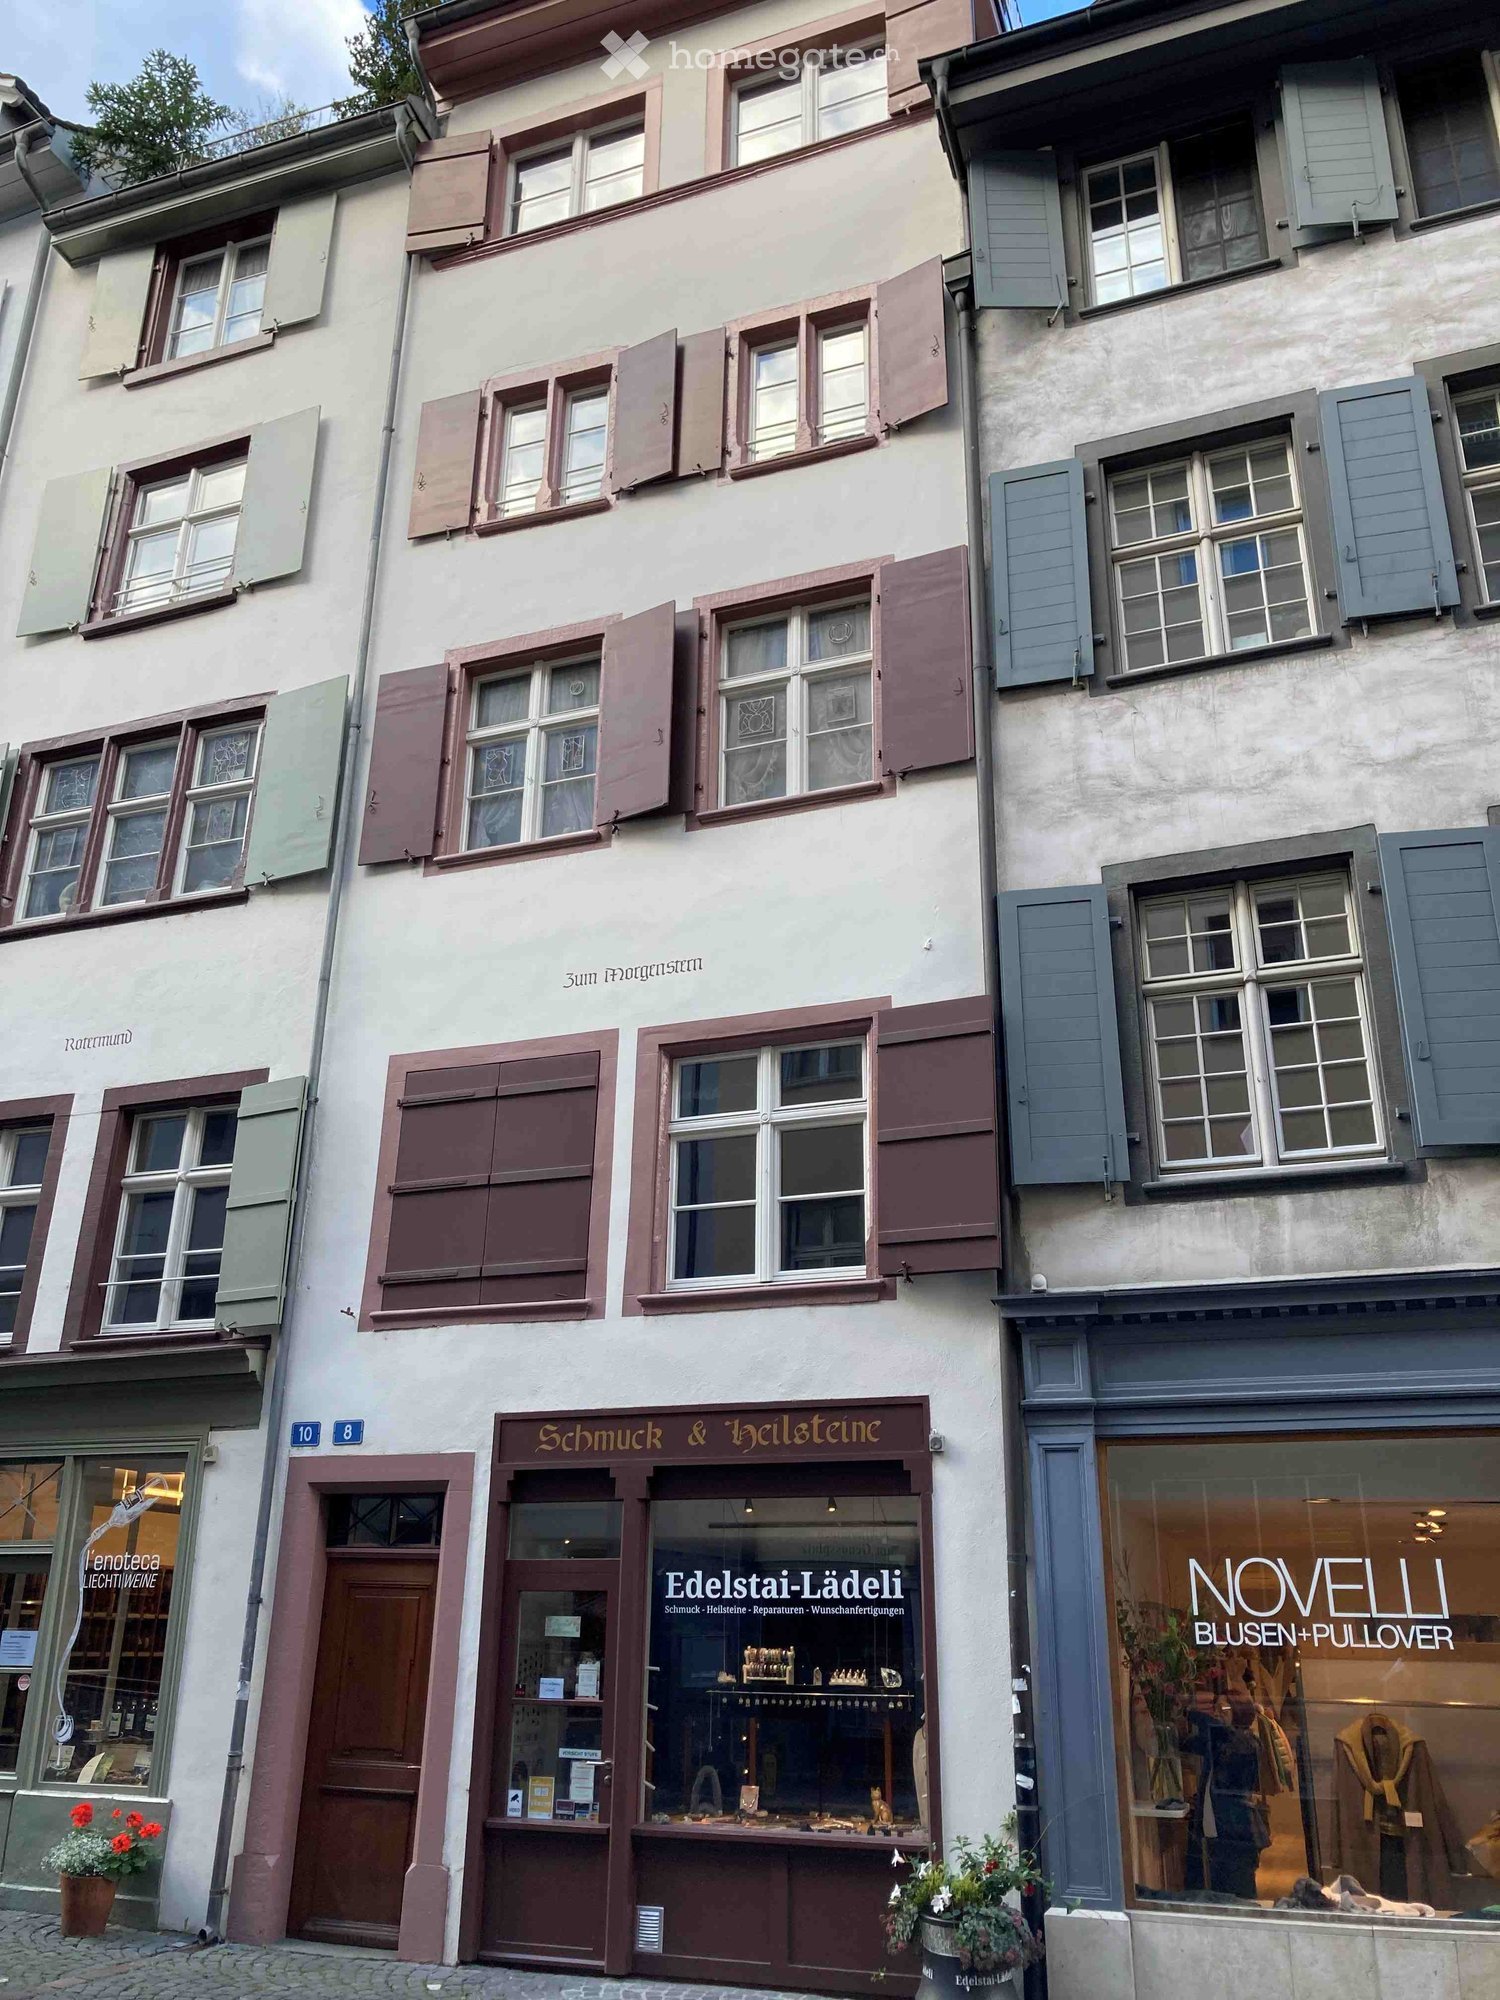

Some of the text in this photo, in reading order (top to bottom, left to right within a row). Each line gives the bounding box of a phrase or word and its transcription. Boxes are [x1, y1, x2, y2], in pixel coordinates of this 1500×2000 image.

[563, 957, 702, 988] Zum Morgenstern
[64, 1029, 133, 1051] Rotermund
[299, 1426, 312, 1441] 10
[343, 1424, 352, 1440] 8
[535, 1414, 882, 1454] Schmuck & Heilsteine
[665, 1569, 904, 1599] Edelstai-Lädeli
[1188, 1557, 1450, 1619] NOVELLI
[664, 1605, 700, 1615] Schmuck
[706, 1604, 747, 1615] Heilsteine
[753, 1605, 804, 1617] Reparaturen
[811, 1605, 905, 1617] Wunschanfertigungen
